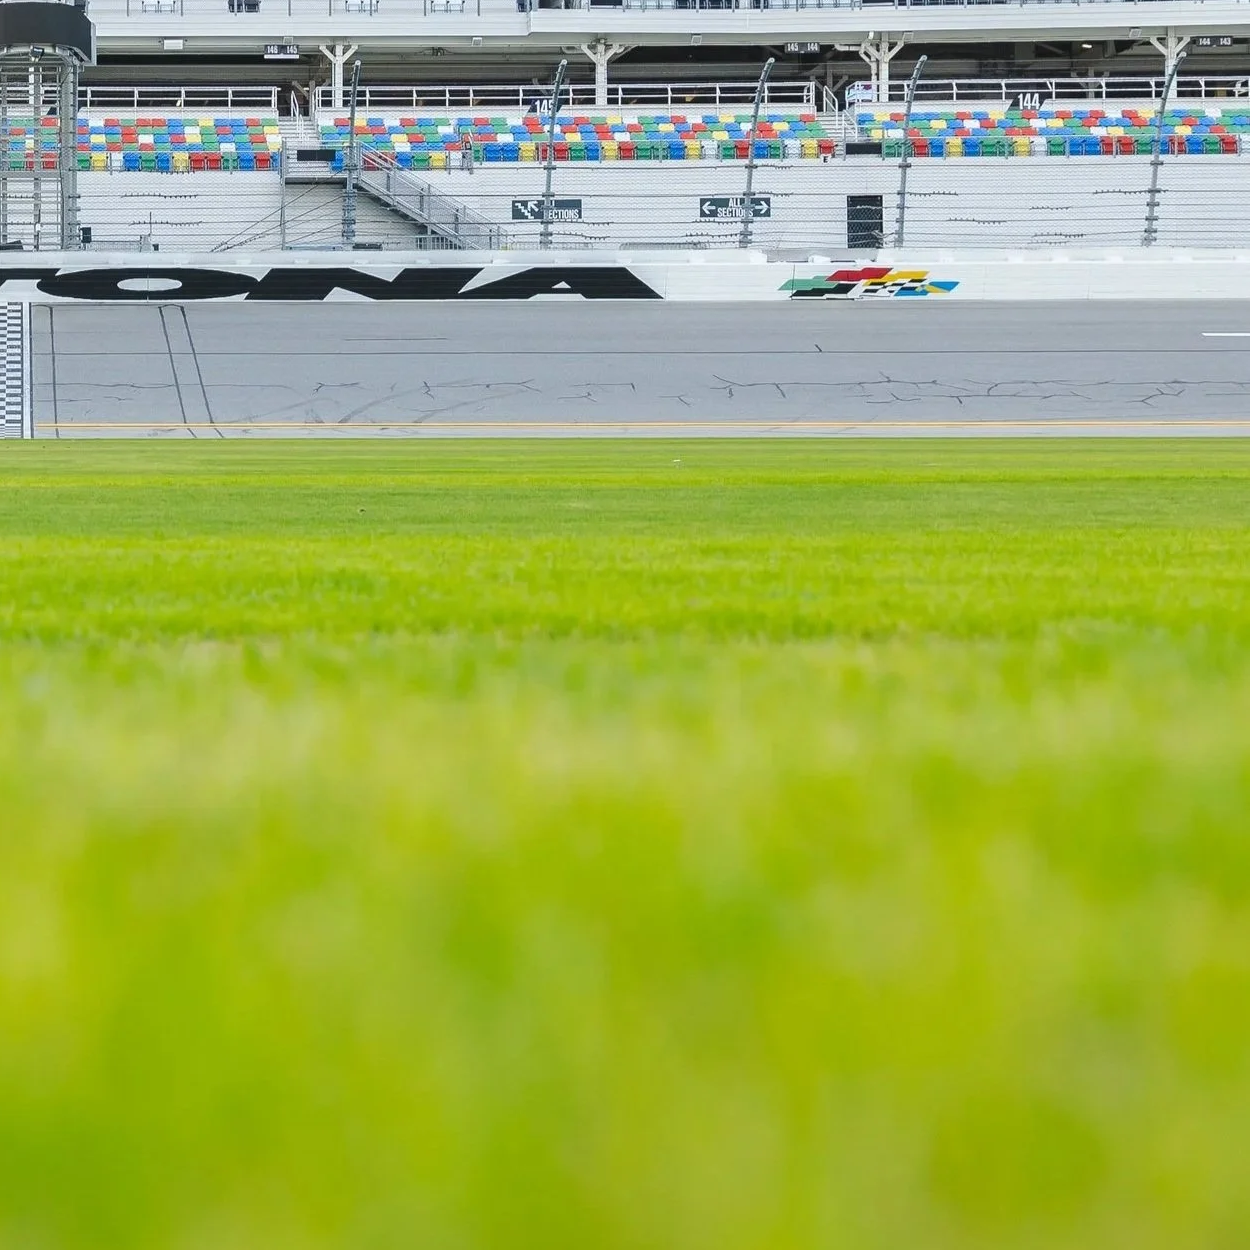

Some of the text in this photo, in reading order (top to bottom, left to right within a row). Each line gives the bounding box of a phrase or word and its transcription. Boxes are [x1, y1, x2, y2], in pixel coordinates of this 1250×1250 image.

[1017, 92, 1040, 110] 144
[729, 197, 742, 208] ALL
[549, 208, 579, 219] ECTIONS
